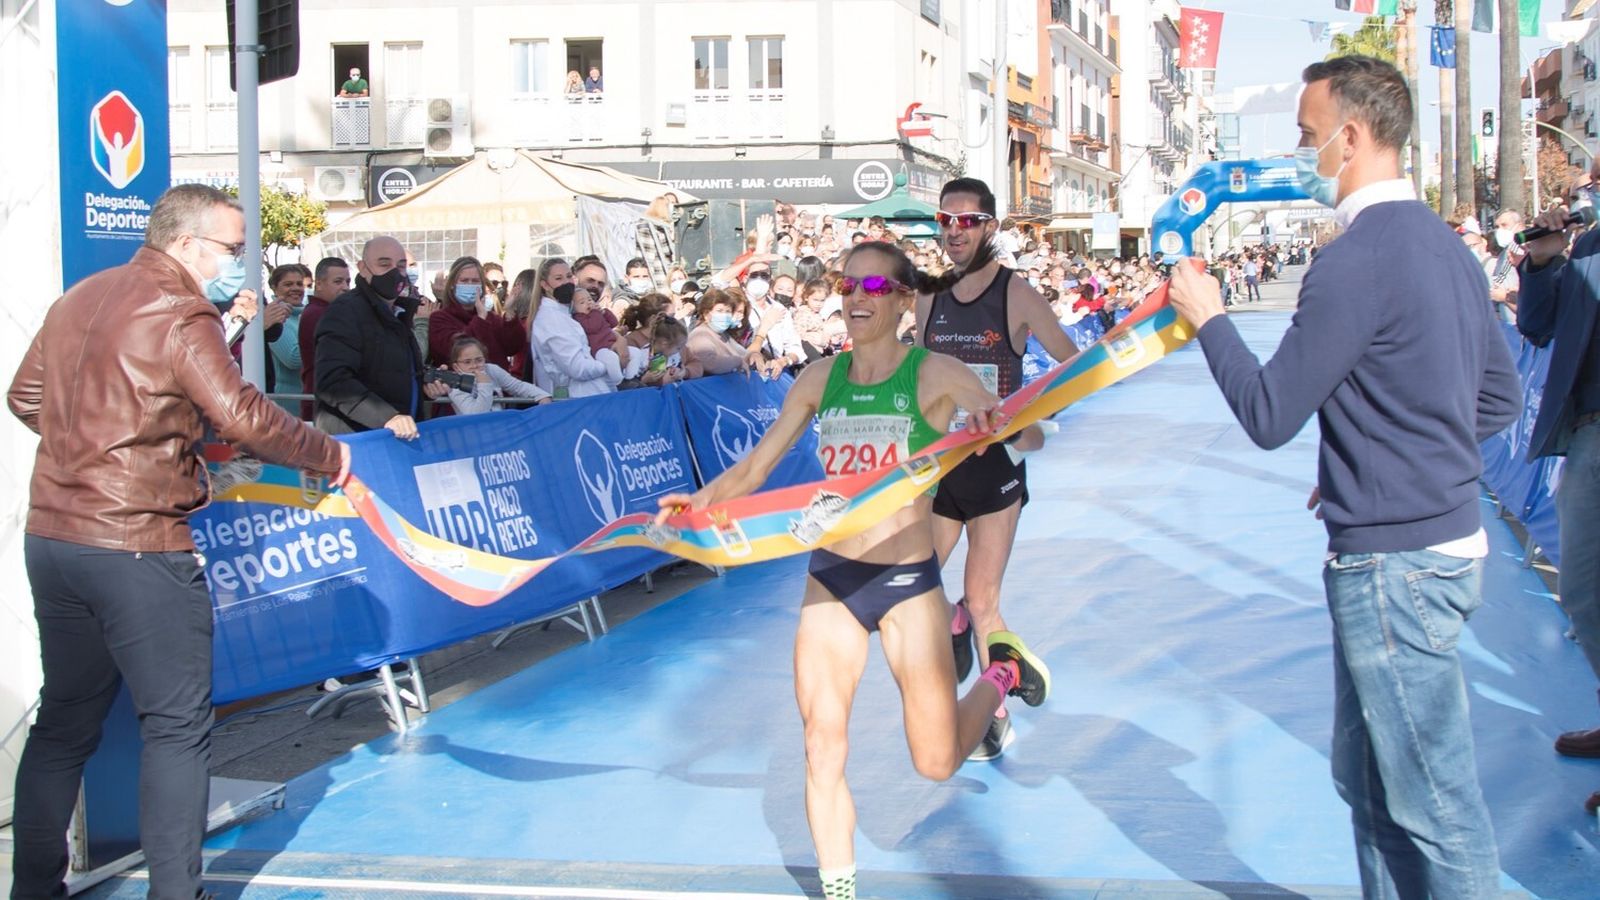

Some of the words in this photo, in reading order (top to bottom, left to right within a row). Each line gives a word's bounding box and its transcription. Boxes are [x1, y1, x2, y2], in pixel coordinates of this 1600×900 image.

[741, 178, 765, 189] BAR
[773, 174, 834, 188] CAFETERÍA
[85, 192, 145, 211] Delegación
[86, 207, 151, 231] Deportes
[614, 433, 671, 461] Delegación
[821, 443, 898, 476] 2294
[478, 449, 531, 487] HIERROS
[621, 457, 683, 493] Deportes
[486, 485, 522, 520] PACO
[496, 515, 538, 553] REYES
